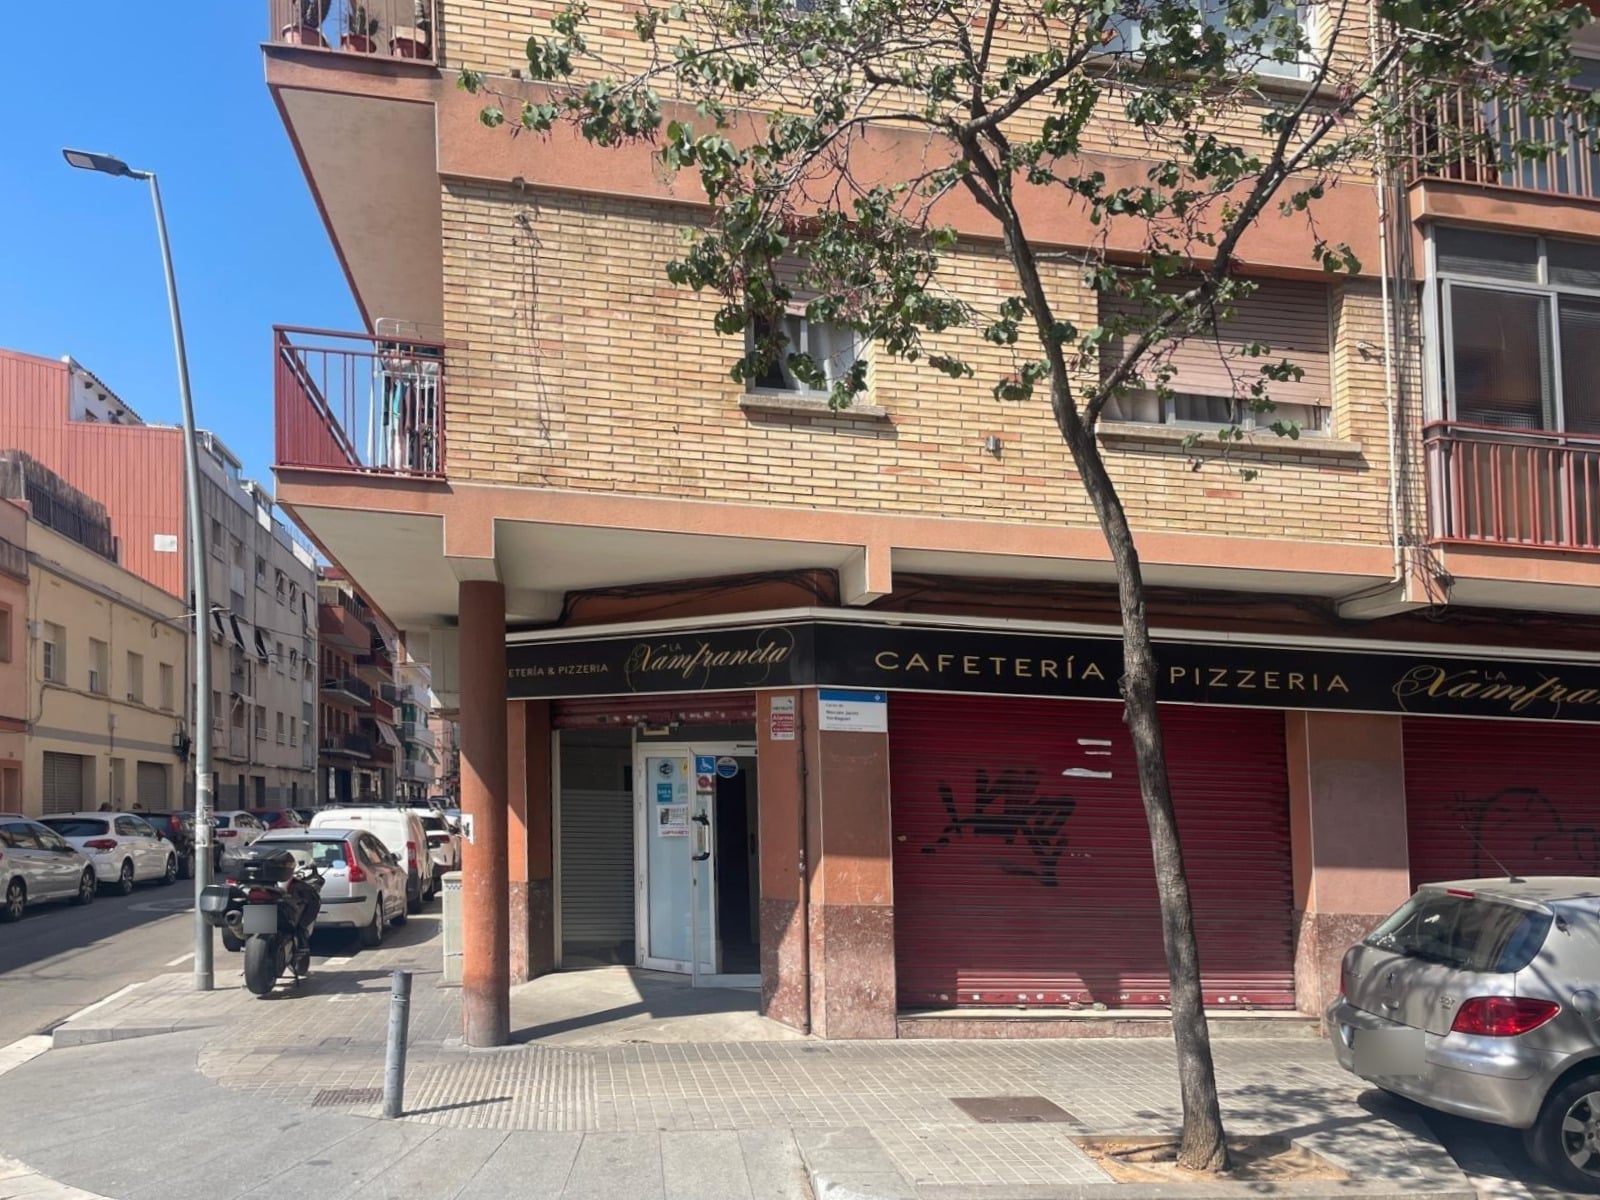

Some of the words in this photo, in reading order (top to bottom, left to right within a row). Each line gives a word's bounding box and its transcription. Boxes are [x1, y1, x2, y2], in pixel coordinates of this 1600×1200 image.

[669, 643, 682, 652] LA
[558, 663, 609, 675] PIZZERIA
[874, 649, 1106, 681] CAFETERÍA
[1169, 665, 1350, 694] PIZZERIA
[1485, 671, 1507, 681] LA
[1393, 666, 1600, 713] Xamfra
